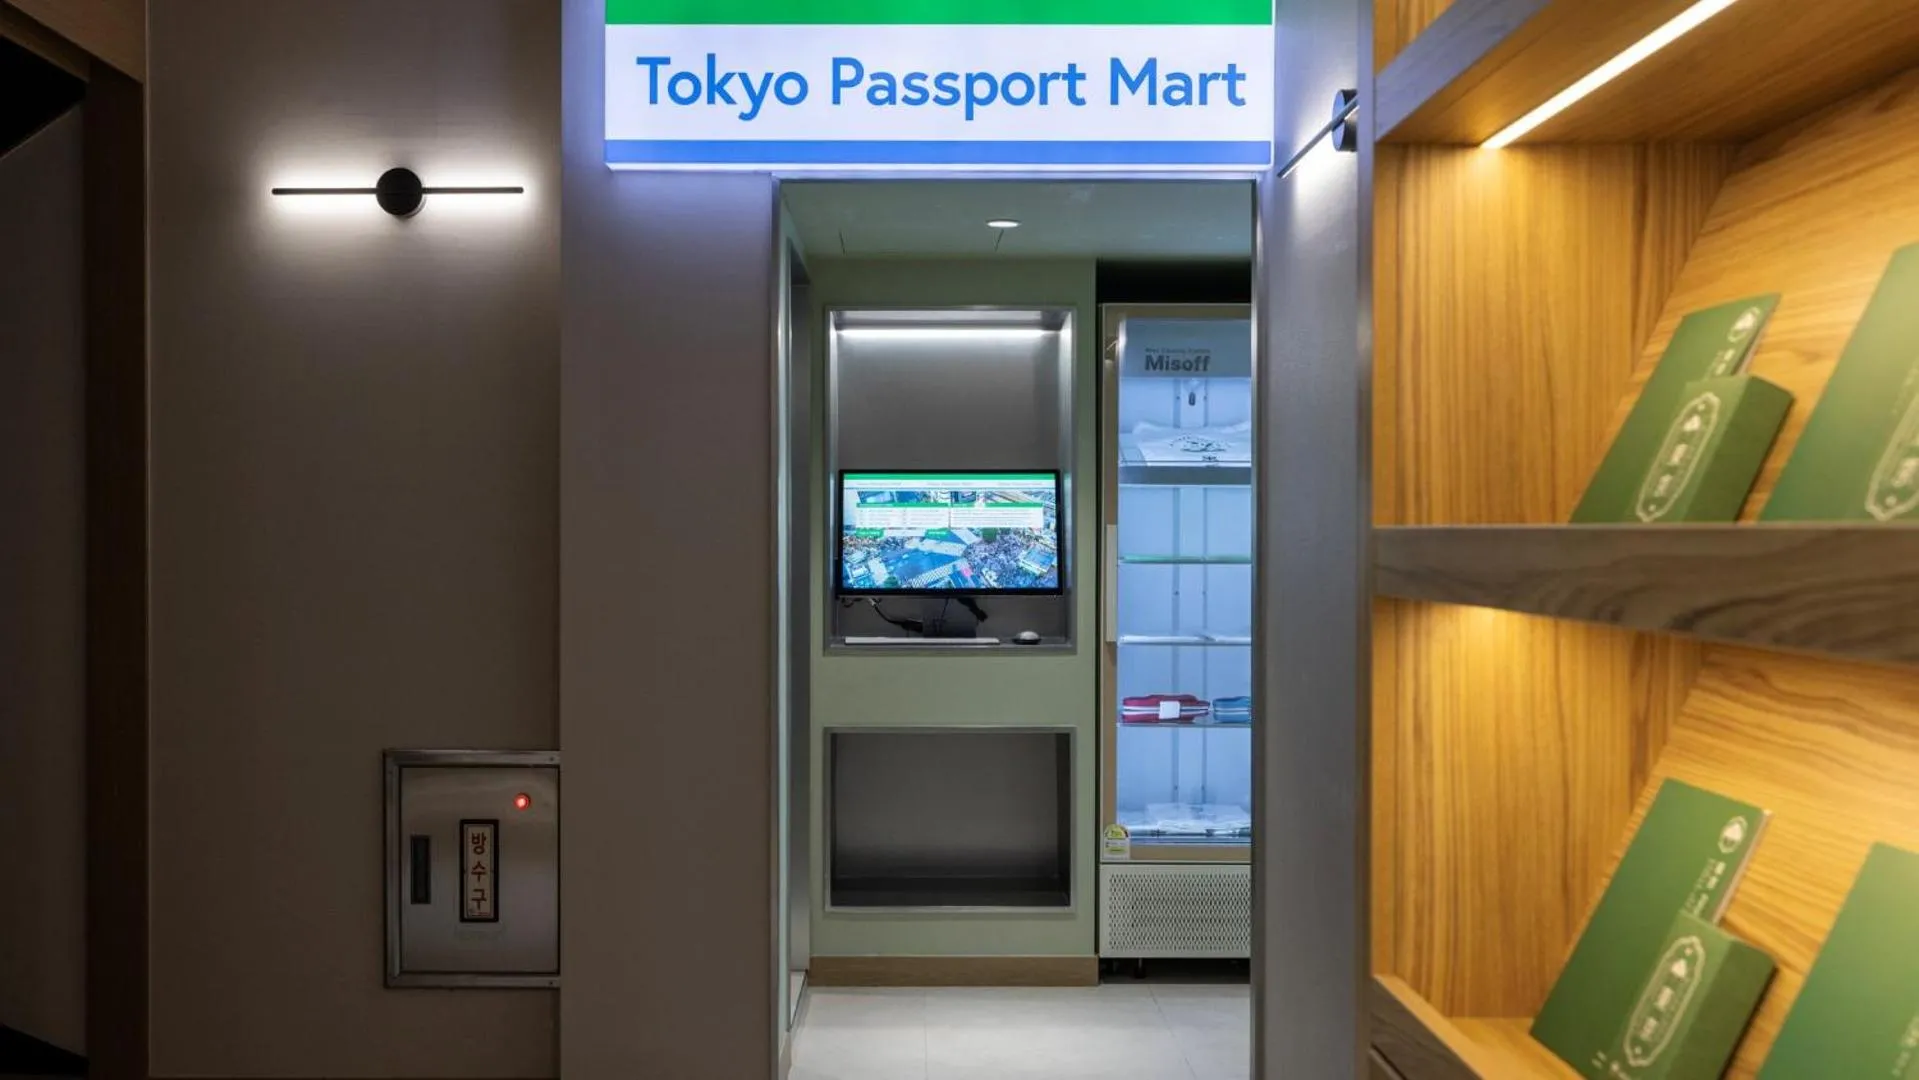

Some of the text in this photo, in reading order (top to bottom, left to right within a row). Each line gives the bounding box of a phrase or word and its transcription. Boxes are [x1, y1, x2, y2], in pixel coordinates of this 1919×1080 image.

[636, 53, 1247, 121] Tokyo Passport Mart
[1145, 354, 1211, 372] Misoff
[470, 831, 488, 911] 방수구
